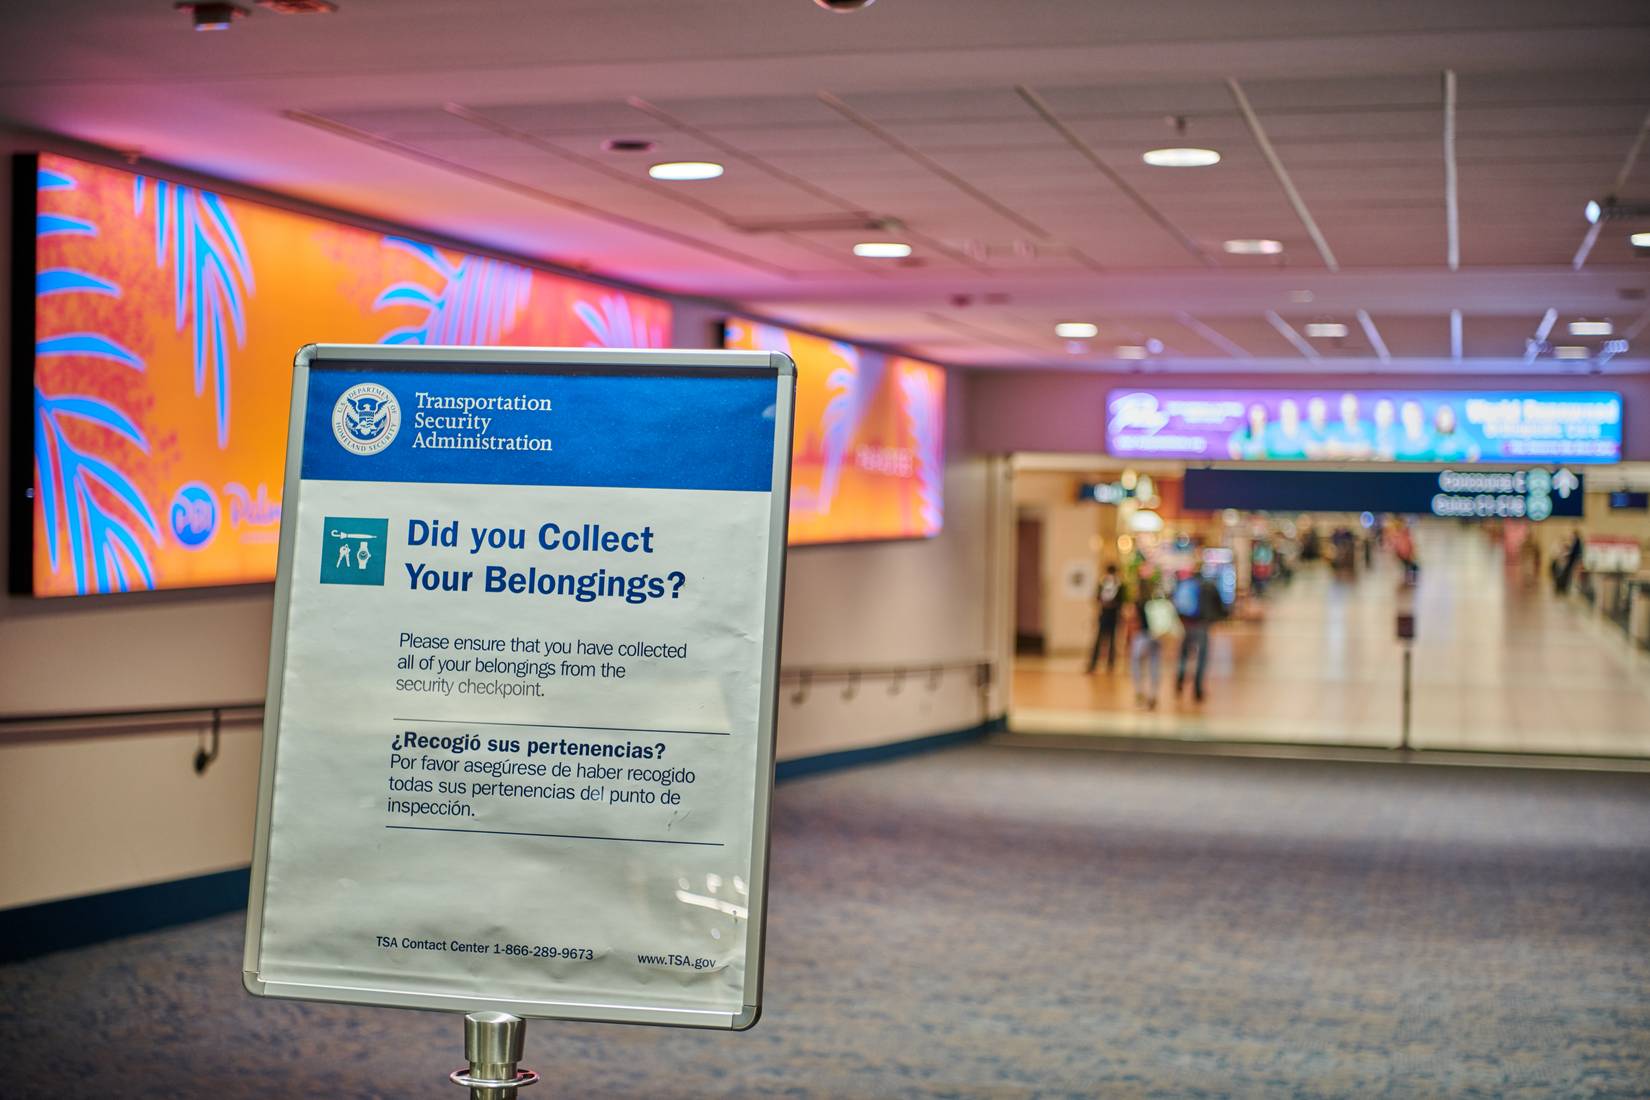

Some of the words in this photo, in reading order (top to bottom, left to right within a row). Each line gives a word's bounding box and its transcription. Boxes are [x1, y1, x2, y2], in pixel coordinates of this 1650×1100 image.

[415, 391, 553, 414] Transportation
[414, 412, 492, 434] Security
[335, 422, 367, 452] HOMELAND
[411, 433, 553, 451] Administration
[408, 520, 458, 547] Did
[470, 528, 525, 554] you
[539, 523, 653, 553] Collect
[405, 563, 473, 591] Your
[485, 566, 685, 604] Belongings?
[400, 633, 449, 649] Please
[454, 638, 505, 651] ensure
[511, 637, 540, 653] that
[544, 642, 571, 656] you
[577, 640, 613, 655] have
[618, 642, 686, 658] collected
[398, 655, 414, 669] all
[419, 656, 435, 670] of
[438, 660, 472, 677] your
[476, 658, 555, 678] belongings
[560, 660, 595, 676] from
[601, 663, 625, 678] the
[396, 678, 454, 696] security
[459, 679, 544, 698] checkpoint.
[392, 732, 480, 755] ¿Recogió
[488, 739, 520, 752] sus
[528, 739, 665, 759] pertenencias?
[391, 754, 417, 769] Por
[421, 757, 459, 771] favor
[464, 760, 546, 777] asegúrese
[552, 762, 571, 777] de
[577, 763, 623, 779] haber
[628, 768, 695, 786] recogido
[389, 776, 432, 792] todas
[439, 782, 466, 794] sus
[472, 782, 575, 799] pertenencias
[581, 786, 604, 800] del
[610, 789, 655, 804] punto
[661, 790, 680, 804] de
[388, 797, 474, 816] inspección.
[377, 936, 397, 947] TSA
[402, 938, 446, 951] Contact
[451, 941, 489, 953] Center
[494, 944, 593, 960] 1-866-289-9673
[638, 955, 715, 969] www.TSA.gov
